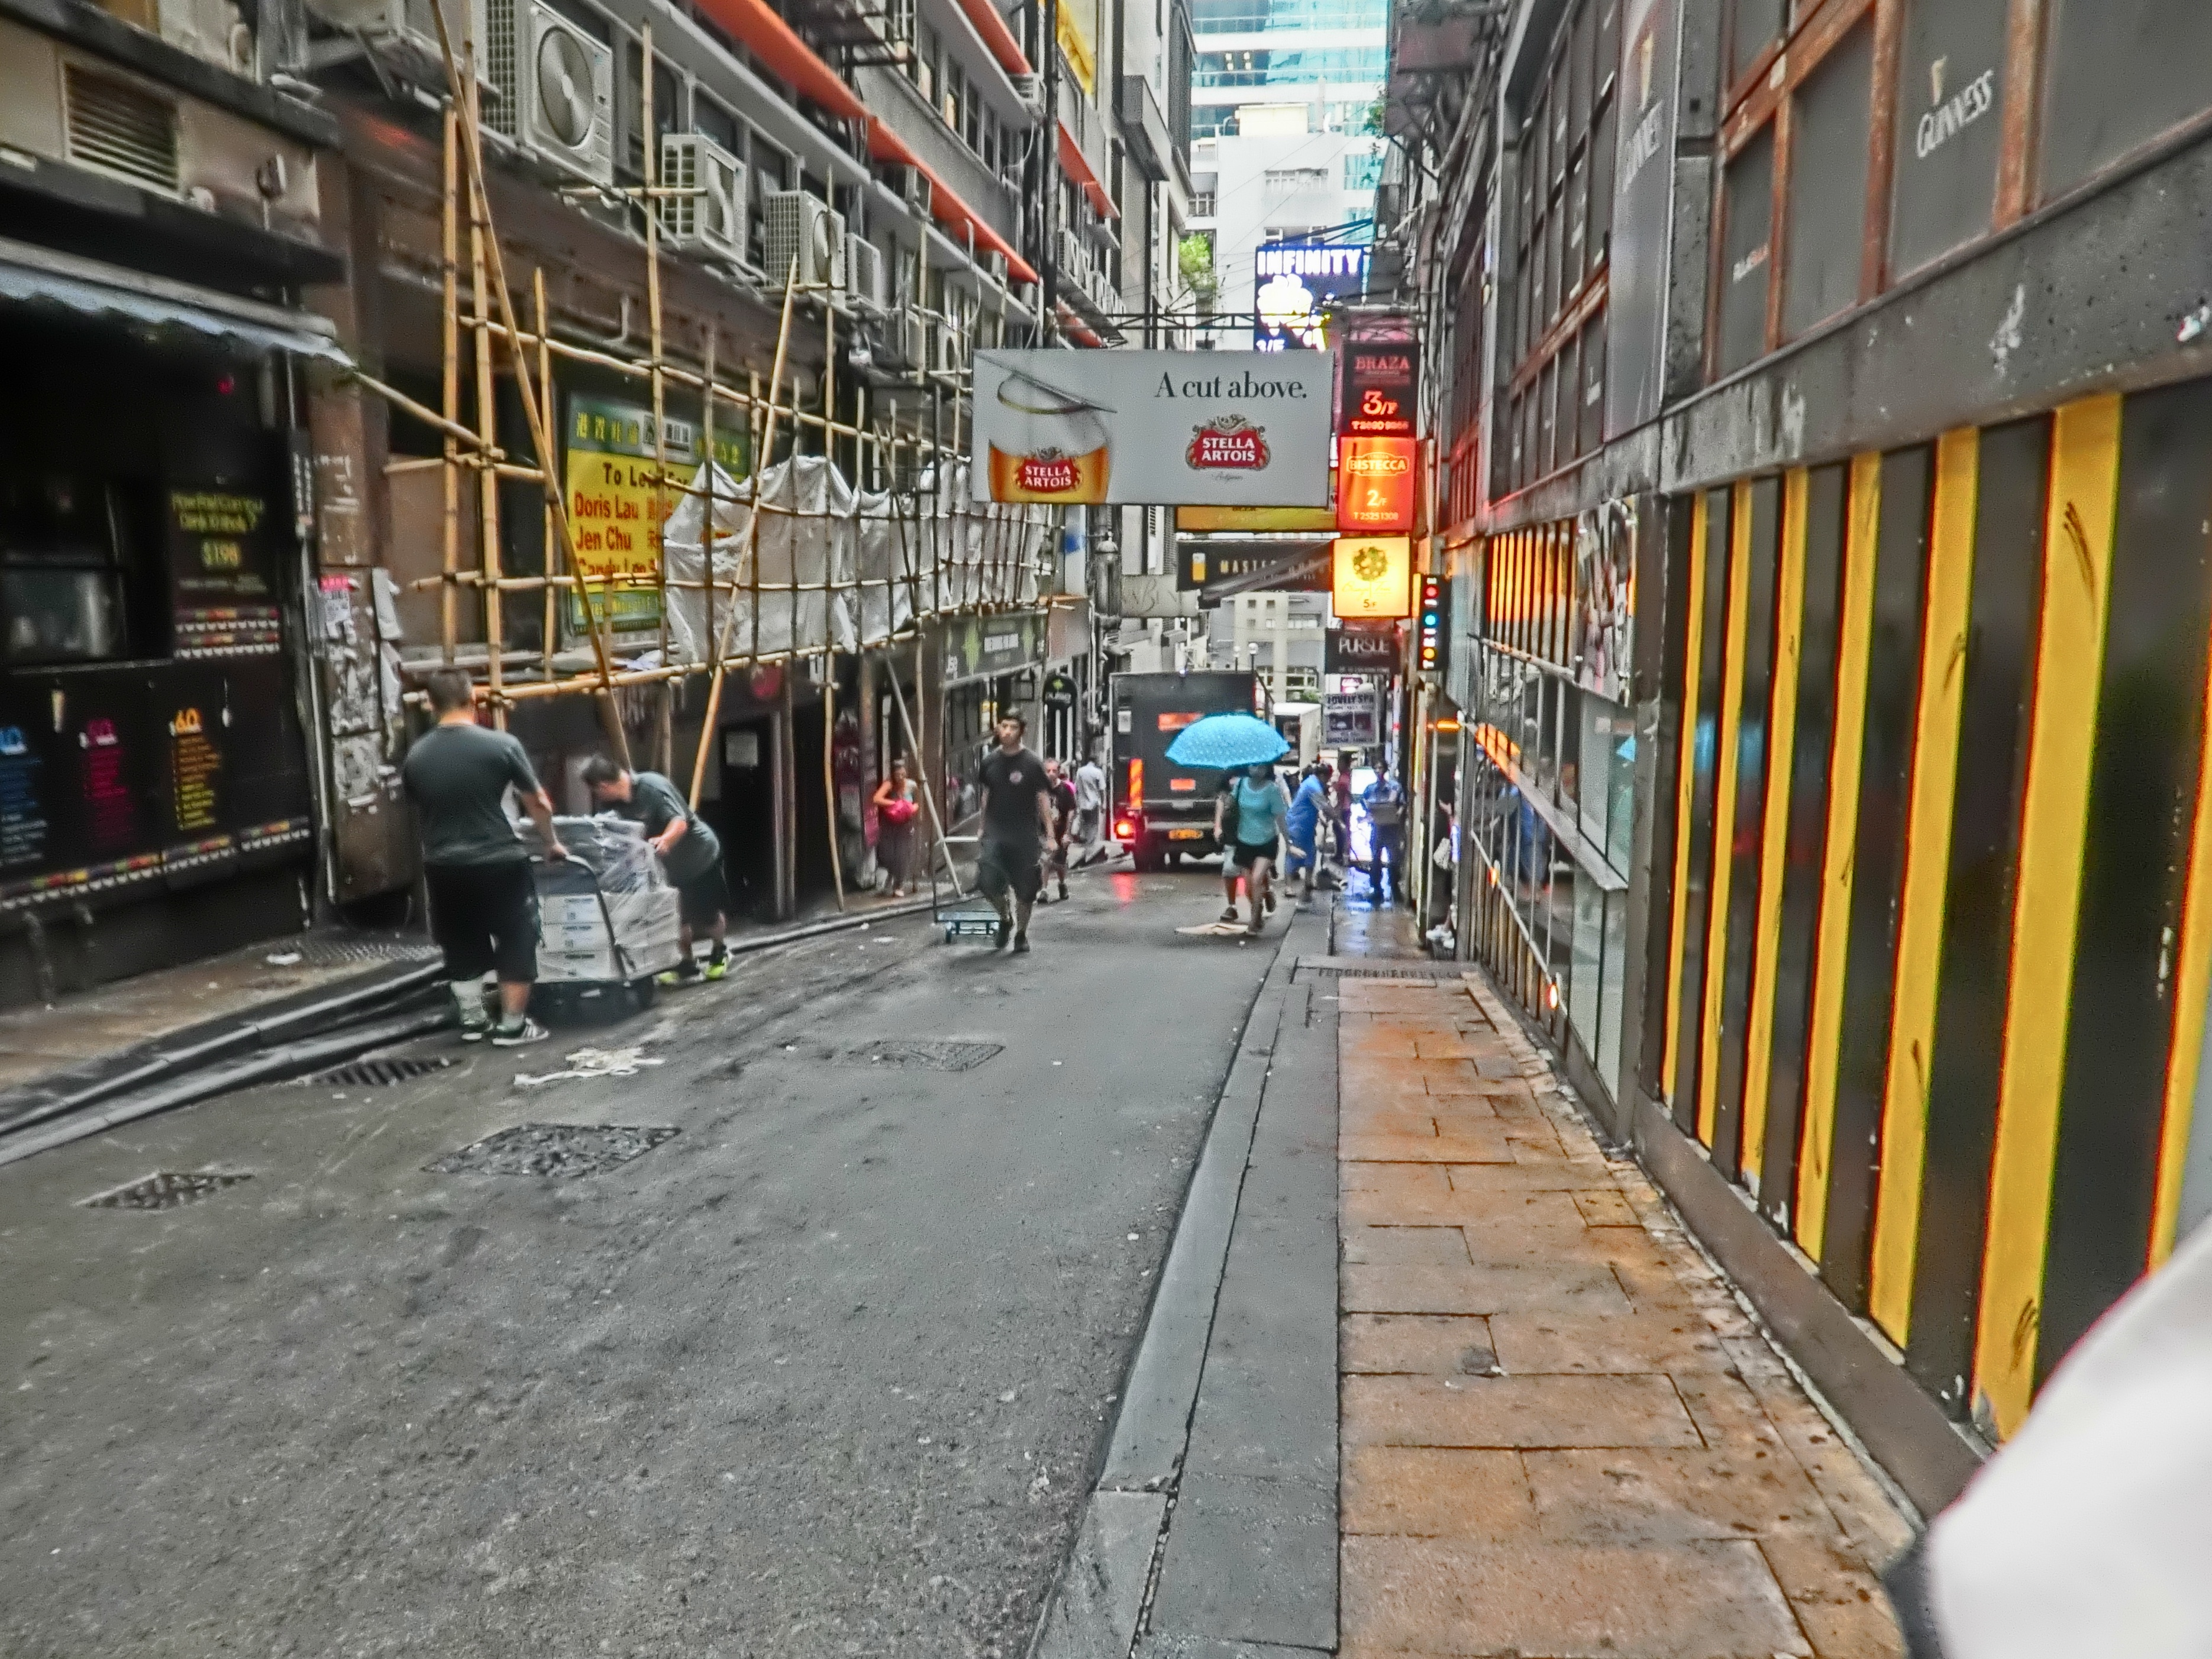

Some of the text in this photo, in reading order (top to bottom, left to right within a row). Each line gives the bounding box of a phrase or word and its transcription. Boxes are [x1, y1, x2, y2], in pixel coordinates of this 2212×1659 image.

[1257, 248, 1361, 276] INFINITY
[1355, 356, 1410, 370] BRAZA
[1155, 371, 1307, 399] A cut above.
[1362, 390, 1397, 415] 3/F
[1203, 437, 1255, 449] STELLA
[1201, 450, 1256, 462] ARTOIS
[1025, 466, 1071, 476] STELLA
[1349, 460, 1406, 470] BISTECCA
[602, 461, 622, 486] To
[1025, 476, 1072, 488] ARTOIS
[574, 491, 611, 518] Doris
[616, 495, 638, 519] Lau
[1367, 490, 1388, 507] 2/F
[576, 527, 601, 550] Jen
[606, 525, 632, 551] Chu
[1338, 637, 1390, 653] PURSUE
